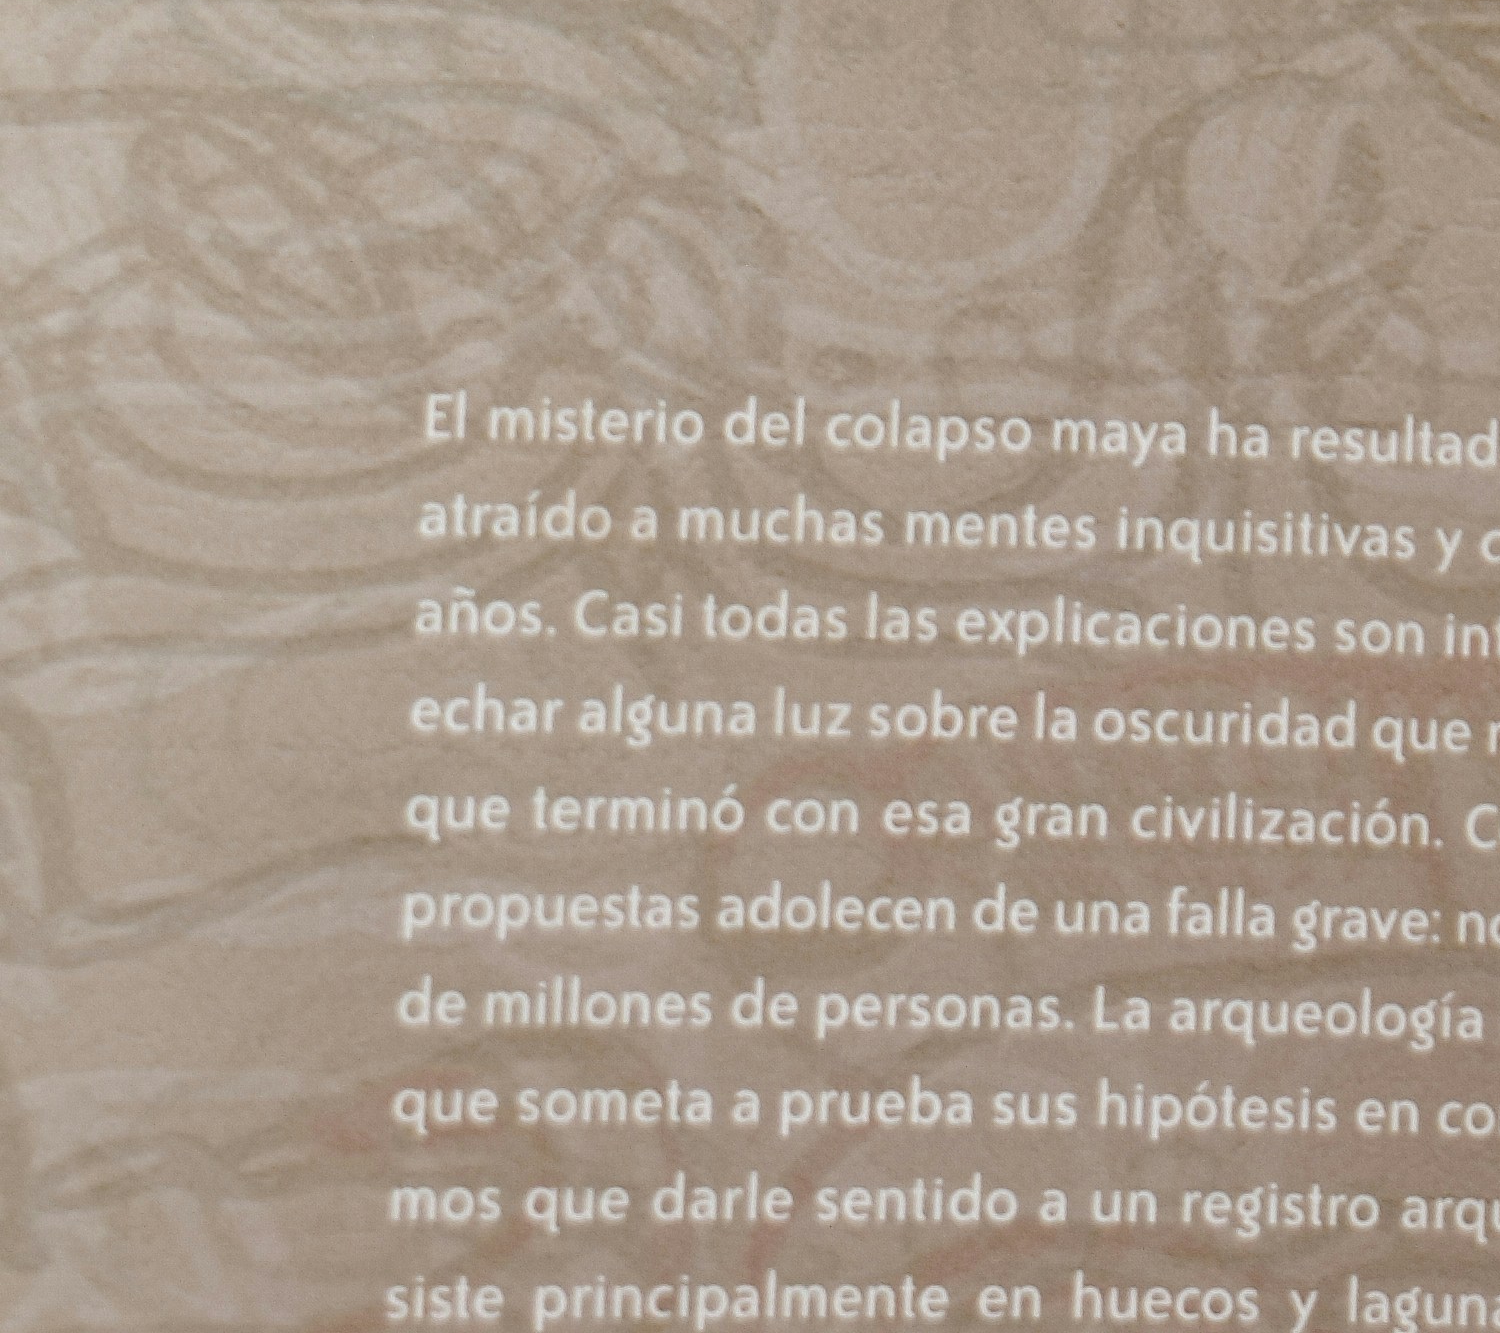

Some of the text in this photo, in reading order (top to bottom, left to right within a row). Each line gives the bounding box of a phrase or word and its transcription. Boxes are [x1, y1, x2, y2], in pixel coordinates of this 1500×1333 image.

[423, 390, 467, 444] El
[488, 397, 704, 451] misterio
[723, 395, 806, 448] del
[824, 398, 1032, 464] colapso
[1051, 418, 1187, 468] maya
[1206, 406, 1270, 460] ha
[417, 489, 613, 541] atraído
[628, 505, 658, 542] a
[677, 493, 884, 547] muchas
[904, 504, 1097, 553] mentes
[1116, 506, 1416, 566] inquisitivas
[1435, 528, 1463, 575] y
[414, 586, 556, 638] años.
[572, 589, 683, 639] Casi
[701, 588, 848, 642] todas
[866, 591, 938, 643] las
[954, 595, 1316, 658] explicaciones
[1333, 618, 1426, 657] son
[408, 682, 564, 735] echar
[576, 683, 757, 749] alguna
[772, 686, 852, 739] luz
[868, 688, 1019, 742] sobre
[1033, 691, 1078, 743] la
[1091, 696, 1357, 751] oscuridad
[1370, 716, 1472, 765] que
[403, 794, 511, 843] que
[531, 783, 745, 834] terminó
[764, 798, 860, 836] con
[881, 799, 972, 838] esa
[993, 796, 1109, 852] gran
[1129, 791, 1443, 848] civilización.
[399, 884, 700, 942] propuestas
[716, 879, 957, 934] adolecen
[971, 882, 1039, 936] de
[1053, 900, 1151, 938] una
[1165, 885, 1276, 940] falla
[1290, 899, 1441, 955] grave:
[395, 974, 467, 1029] de
[482, 975, 713, 1030] millones
[729, 976, 799, 1030] de
[814, 992, 1075, 1041] personas.
[1091, 985, 1151, 1034] La
[1167, 986, 1485, 1054] arqueología
[390, 1087, 499, 1137] que
[515, 1079, 714, 1127] someta
[729, 1088, 761, 1127] a
[778, 1075, 974, 1139] prueba
[991, 1091, 1078, 1129] sus
[1096, 1077, 1338, 1142] hipótesis
[1354, 1098, 1420, 1136] en
[387, 1186, 502, 1226] mos
[522, 1186, 630, 1235] que
[649, 1170, 794, 1224] darle
[814, 1171, 1019, 1226] sentido
[1037, 1188, 1068, 1226] a
[1089, 1189, 1158, 1226] un
[1180, 1182, 1380, 1242] registro
[384, 1275, 505, 1324] siste
[531, 1268, 951, 1333] principalmente
[976, 1284, 1042, 1322] en
[1070, 1269, 1260, 1326] huecos
[1288, 1289, 1318, 1333] y
